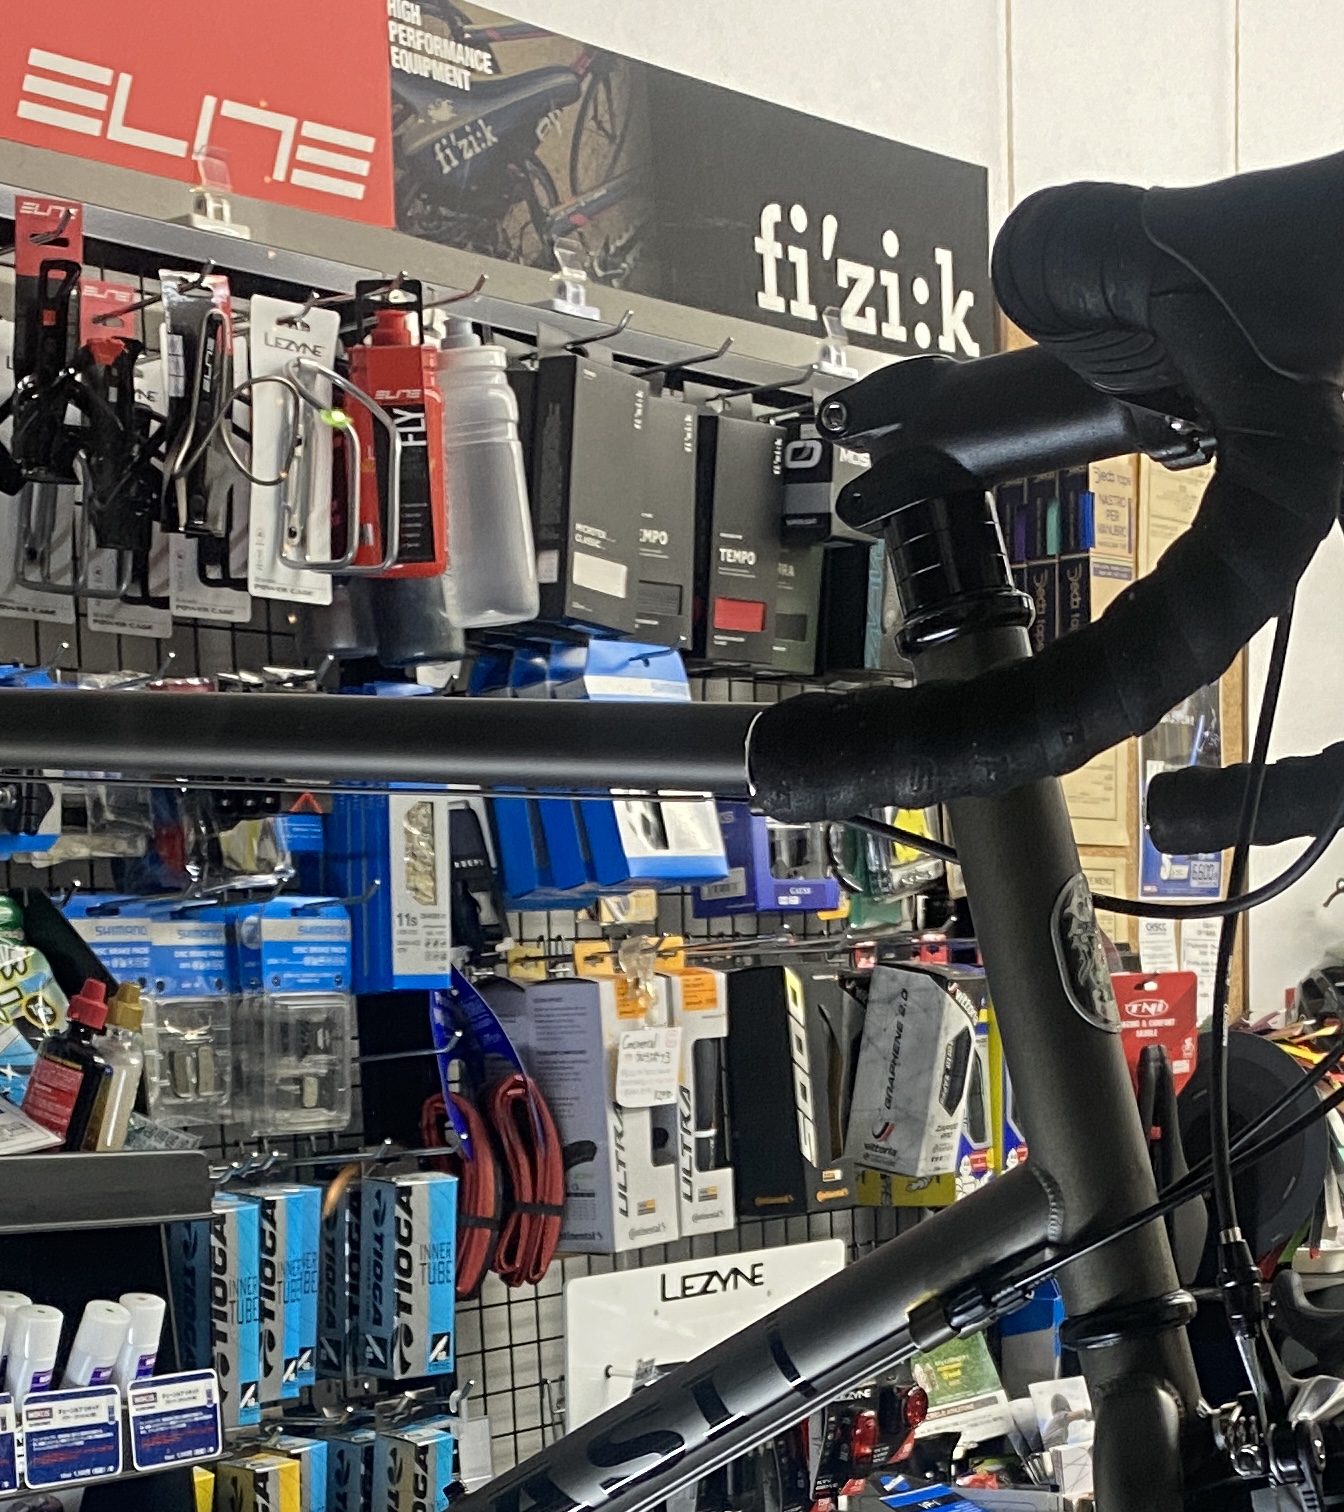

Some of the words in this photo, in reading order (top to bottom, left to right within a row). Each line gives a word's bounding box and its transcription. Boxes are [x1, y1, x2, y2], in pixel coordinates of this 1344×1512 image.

[387, 0, 421, 26] HIGH
[388, 21, 493, 75] PERFORMANCE
[390, 46, 471, 91] EQUIPMENT
[17, 48, 376, 200] ELITE
[264, 331, 326, 358] LEZYNE
[393, 407, 427, 448] FLY
[839, 447, 872, 468] MOS
[719, 548, 757, 565] TEMPO
[94, 925, 148, 937] SHIMANO
[296, 925, 347, 936] SHIMANO
[395, 912, 419, 928] 11s
[884, 1018, 908, 1111] GRAPHENE
[612, 1102, 629, 1218] ULTRA
[678, 1084, 694, 1203] ULTRA
[260, 1199, 277, 1324] TIOGA
[393, 1187, 413, 1318] TIOGA
[420, 1241, 452, 1262] INNER
[211, 1213, 229, 1348] TIOGA
[420, 1260, 453, 1287] TUBE
[660, 1261, 764, 1302] LEZYNE
